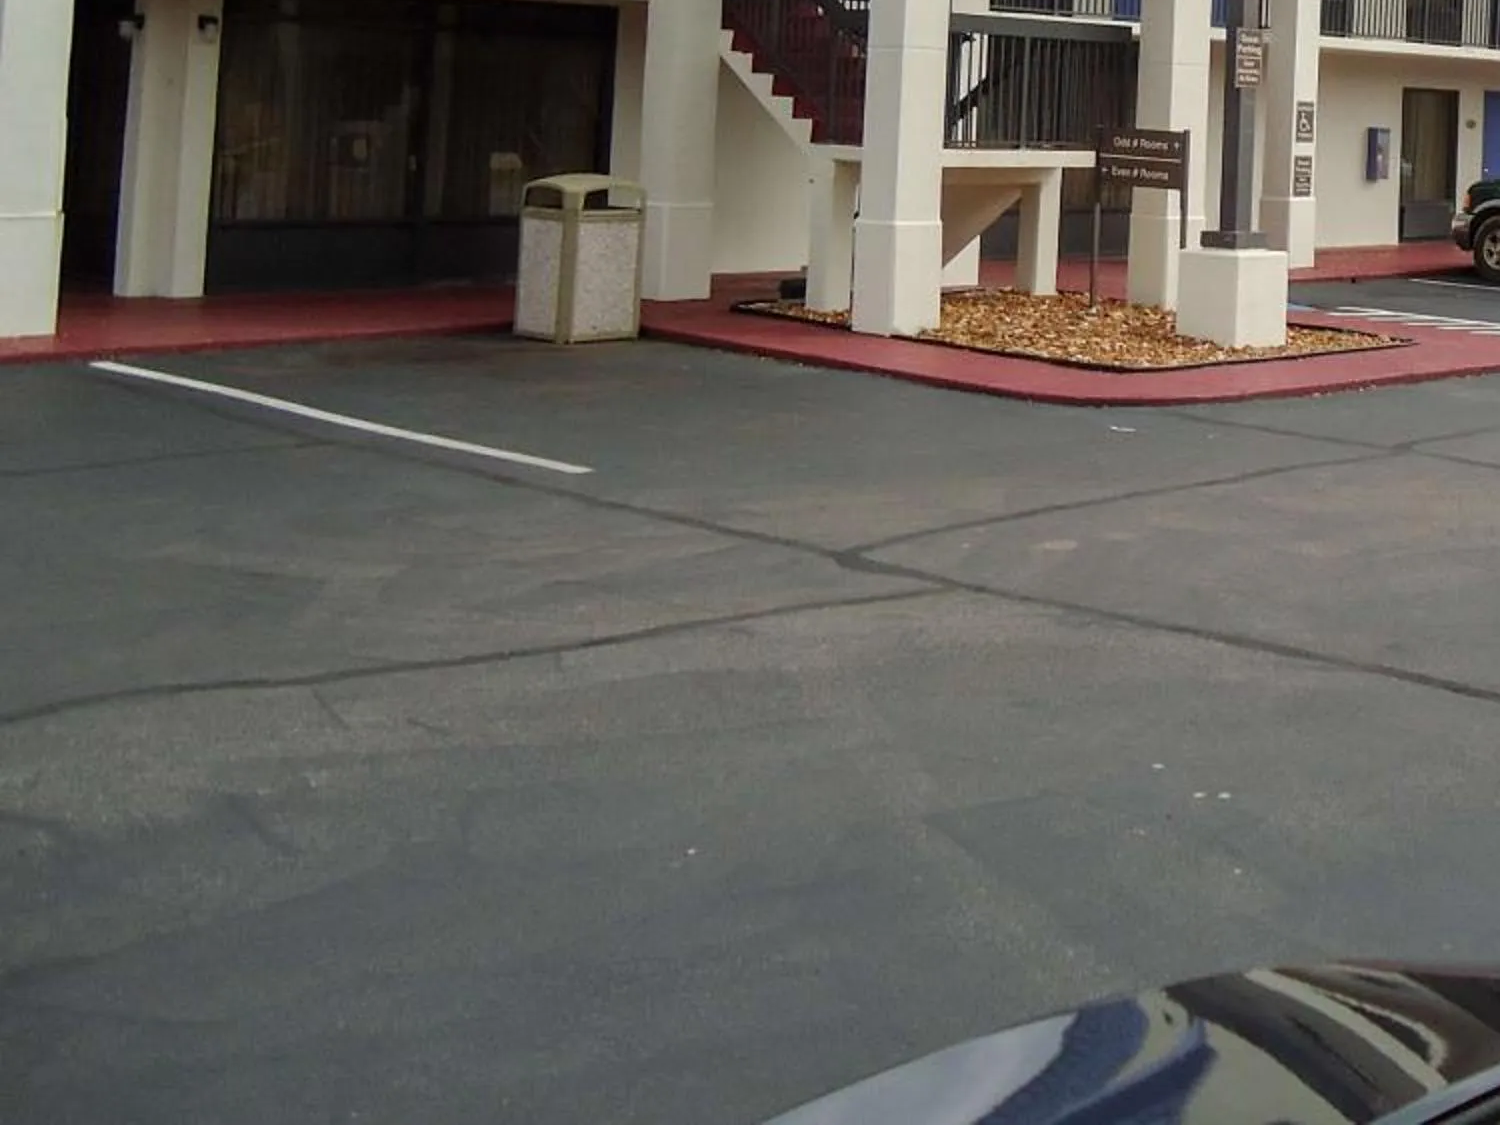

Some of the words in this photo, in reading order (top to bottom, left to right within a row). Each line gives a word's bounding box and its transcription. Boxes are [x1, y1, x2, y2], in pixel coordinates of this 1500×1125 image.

[1113, 136, 1131, 148] Odd
[1140, 138, 1169, 150] Rooms
[1111, 165, 1131, 178] Even
[1140, 168, 1169, 181] Rooms
